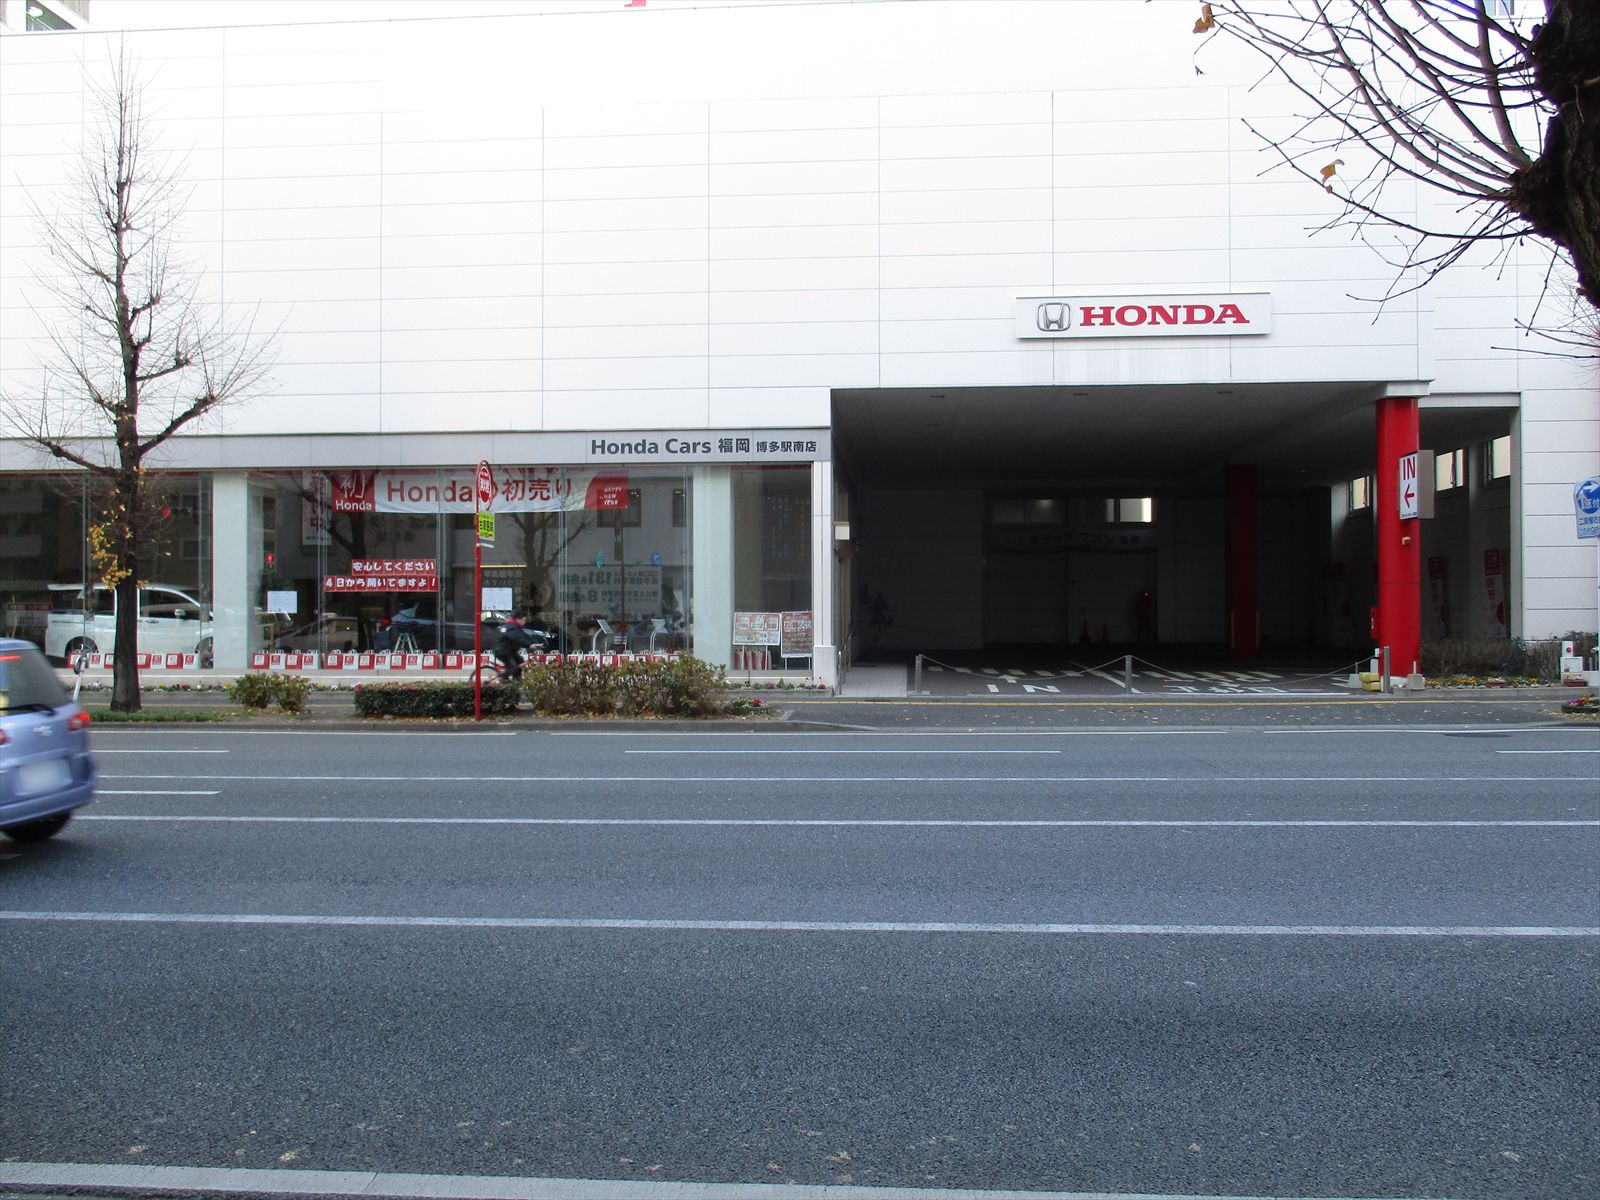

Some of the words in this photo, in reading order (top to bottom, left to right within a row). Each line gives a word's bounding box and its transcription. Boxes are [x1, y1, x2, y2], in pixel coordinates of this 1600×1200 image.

[1079, 303, 1250, 327] HONDA
[591, 439, 659, 455] Honda
[665, 438, 712, 454] Cars
[718, 437, 750, 453] 福岡
[756, 441, 817, 453] 博多駅南店
[1402, 456, 1416, 481] IN
[335, 500, 372, 511] Honda
[352, 561, 435, 573] 安心してください
